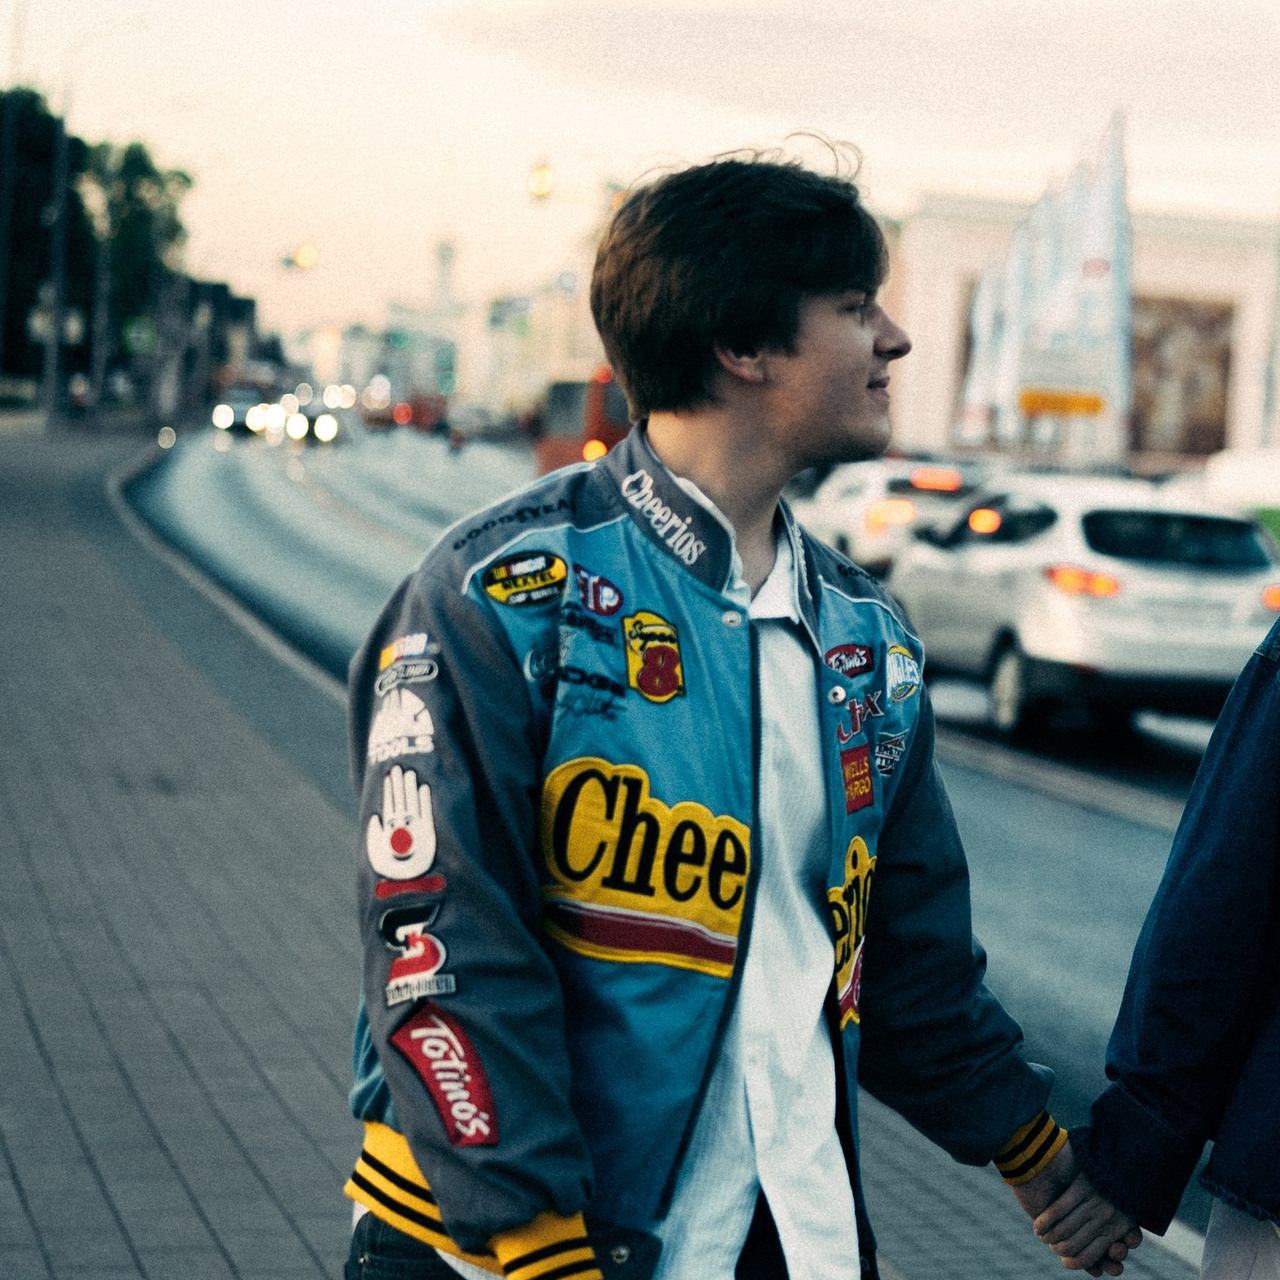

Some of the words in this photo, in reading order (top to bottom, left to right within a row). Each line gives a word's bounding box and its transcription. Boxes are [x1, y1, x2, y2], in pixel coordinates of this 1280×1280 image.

[621, 469, 708, 566] Cheerios
[637, 645, 680, 698] 8
[844, 756, 870, 783] WELLS
[846, 776, 871, 801] FARGO
[553, 768, 747, 911] Chee
[410, 1013, 491, 1137] Totino's
